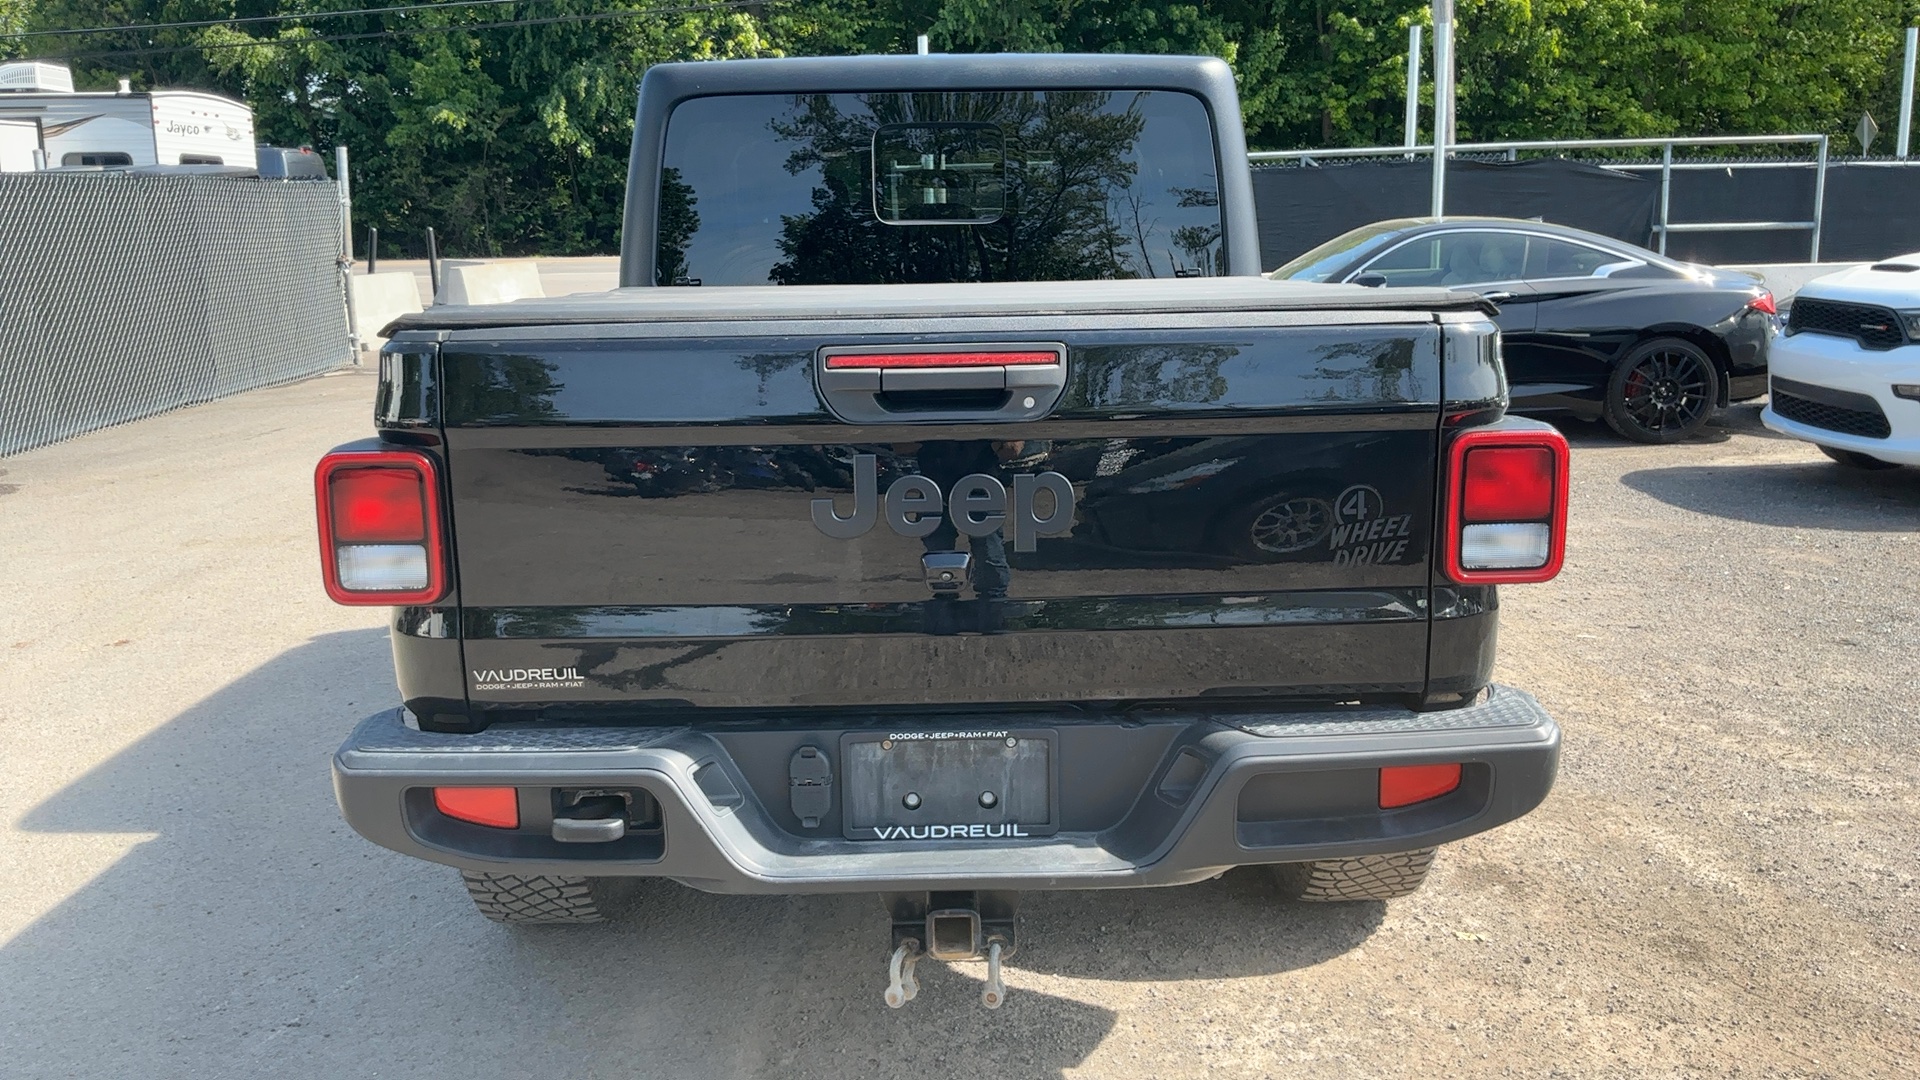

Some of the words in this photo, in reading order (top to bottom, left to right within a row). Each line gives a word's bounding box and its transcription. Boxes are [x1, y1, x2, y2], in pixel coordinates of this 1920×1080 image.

[166, 120, 200, 137] Jayco
[811, 454, 1075, 552] Jeep
[1342, 490, 1368, 520] 4
[1329, 514, 1412, 550] WHEEL
[1333, 540, 1409, 569] DRIVE
[473, 667, 585, 682] VAUDREUIL
[873, 824, 1029, 840] VAUDREUIL
